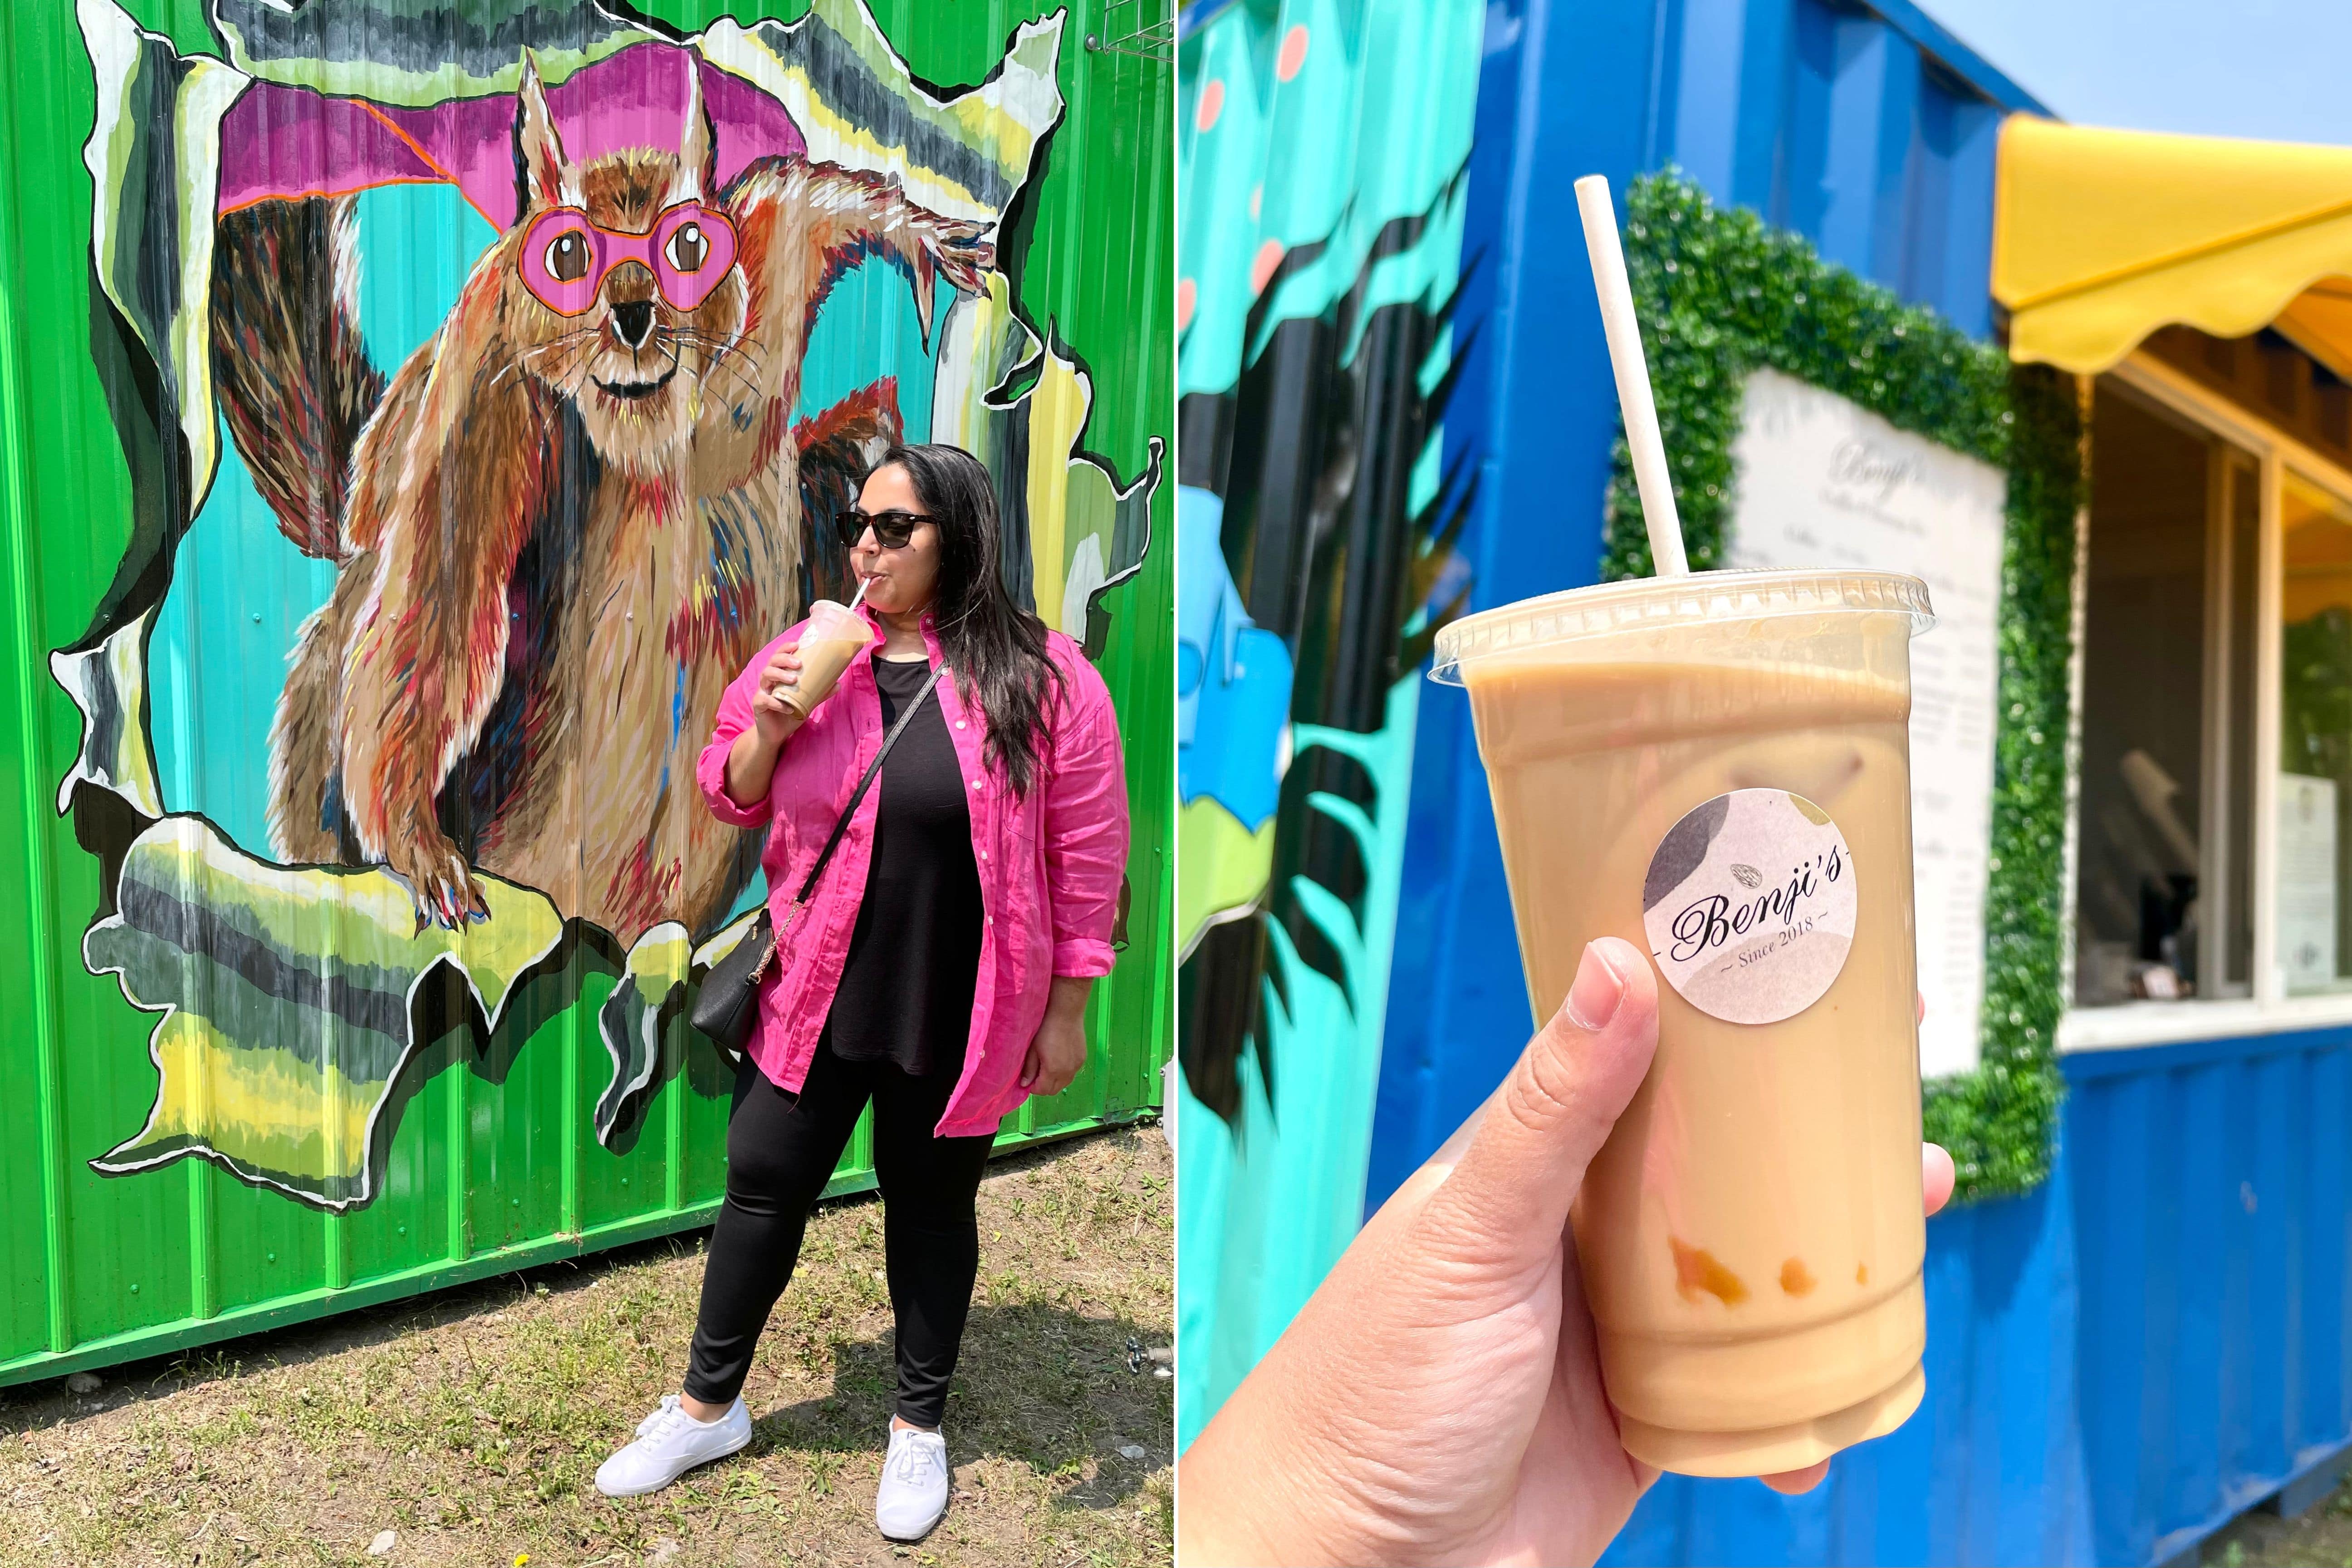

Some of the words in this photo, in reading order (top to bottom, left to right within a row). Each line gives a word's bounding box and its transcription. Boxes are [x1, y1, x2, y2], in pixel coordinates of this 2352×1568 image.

[1671, 845, 1841, 961] Benji's
[1739, 941, 1775, 968] Since
[1779, 916, 1813, 947] 2018
